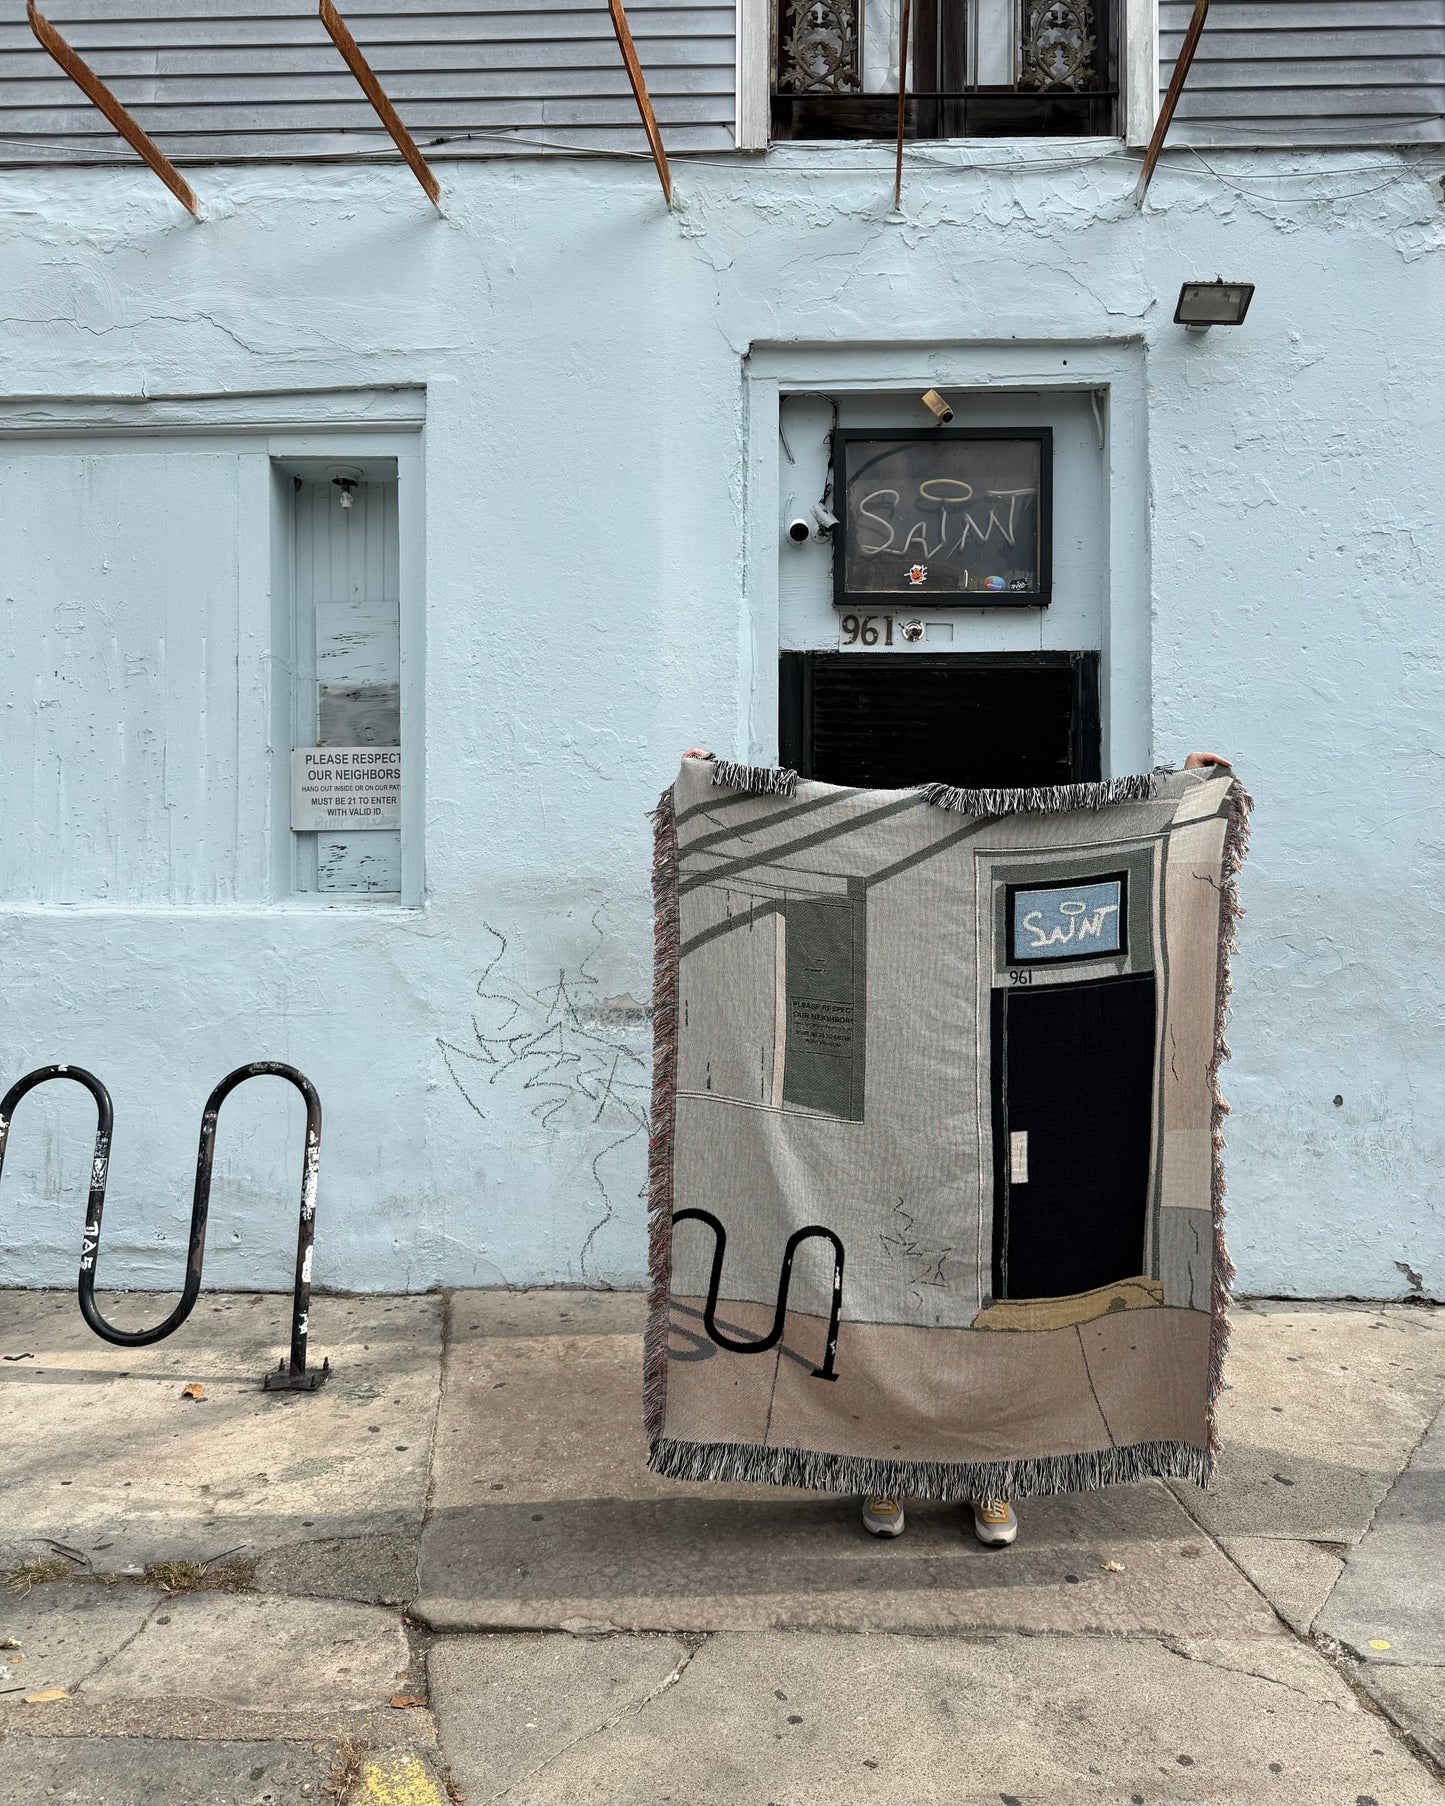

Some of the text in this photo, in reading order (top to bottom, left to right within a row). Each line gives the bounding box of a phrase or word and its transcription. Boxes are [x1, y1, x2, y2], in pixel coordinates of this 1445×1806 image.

[859, 486, 1037, 561] SAINT
[841, 614, 894, 646] 961
[305, 754, 349, 765] PLEASE
[308, 768, 401, 781] OUR NEIGHBORS
[301, 785, 319, 793] HANG
[354, 784, 364, 792] OR
[311, 796, 397, 806] MUST BE 21 TO ENTER
[327, 807, 382, 816] WITH VALID ID
[1009, 969, 1032, 985] 961
[792, 1010, 810, 1020] OUR
